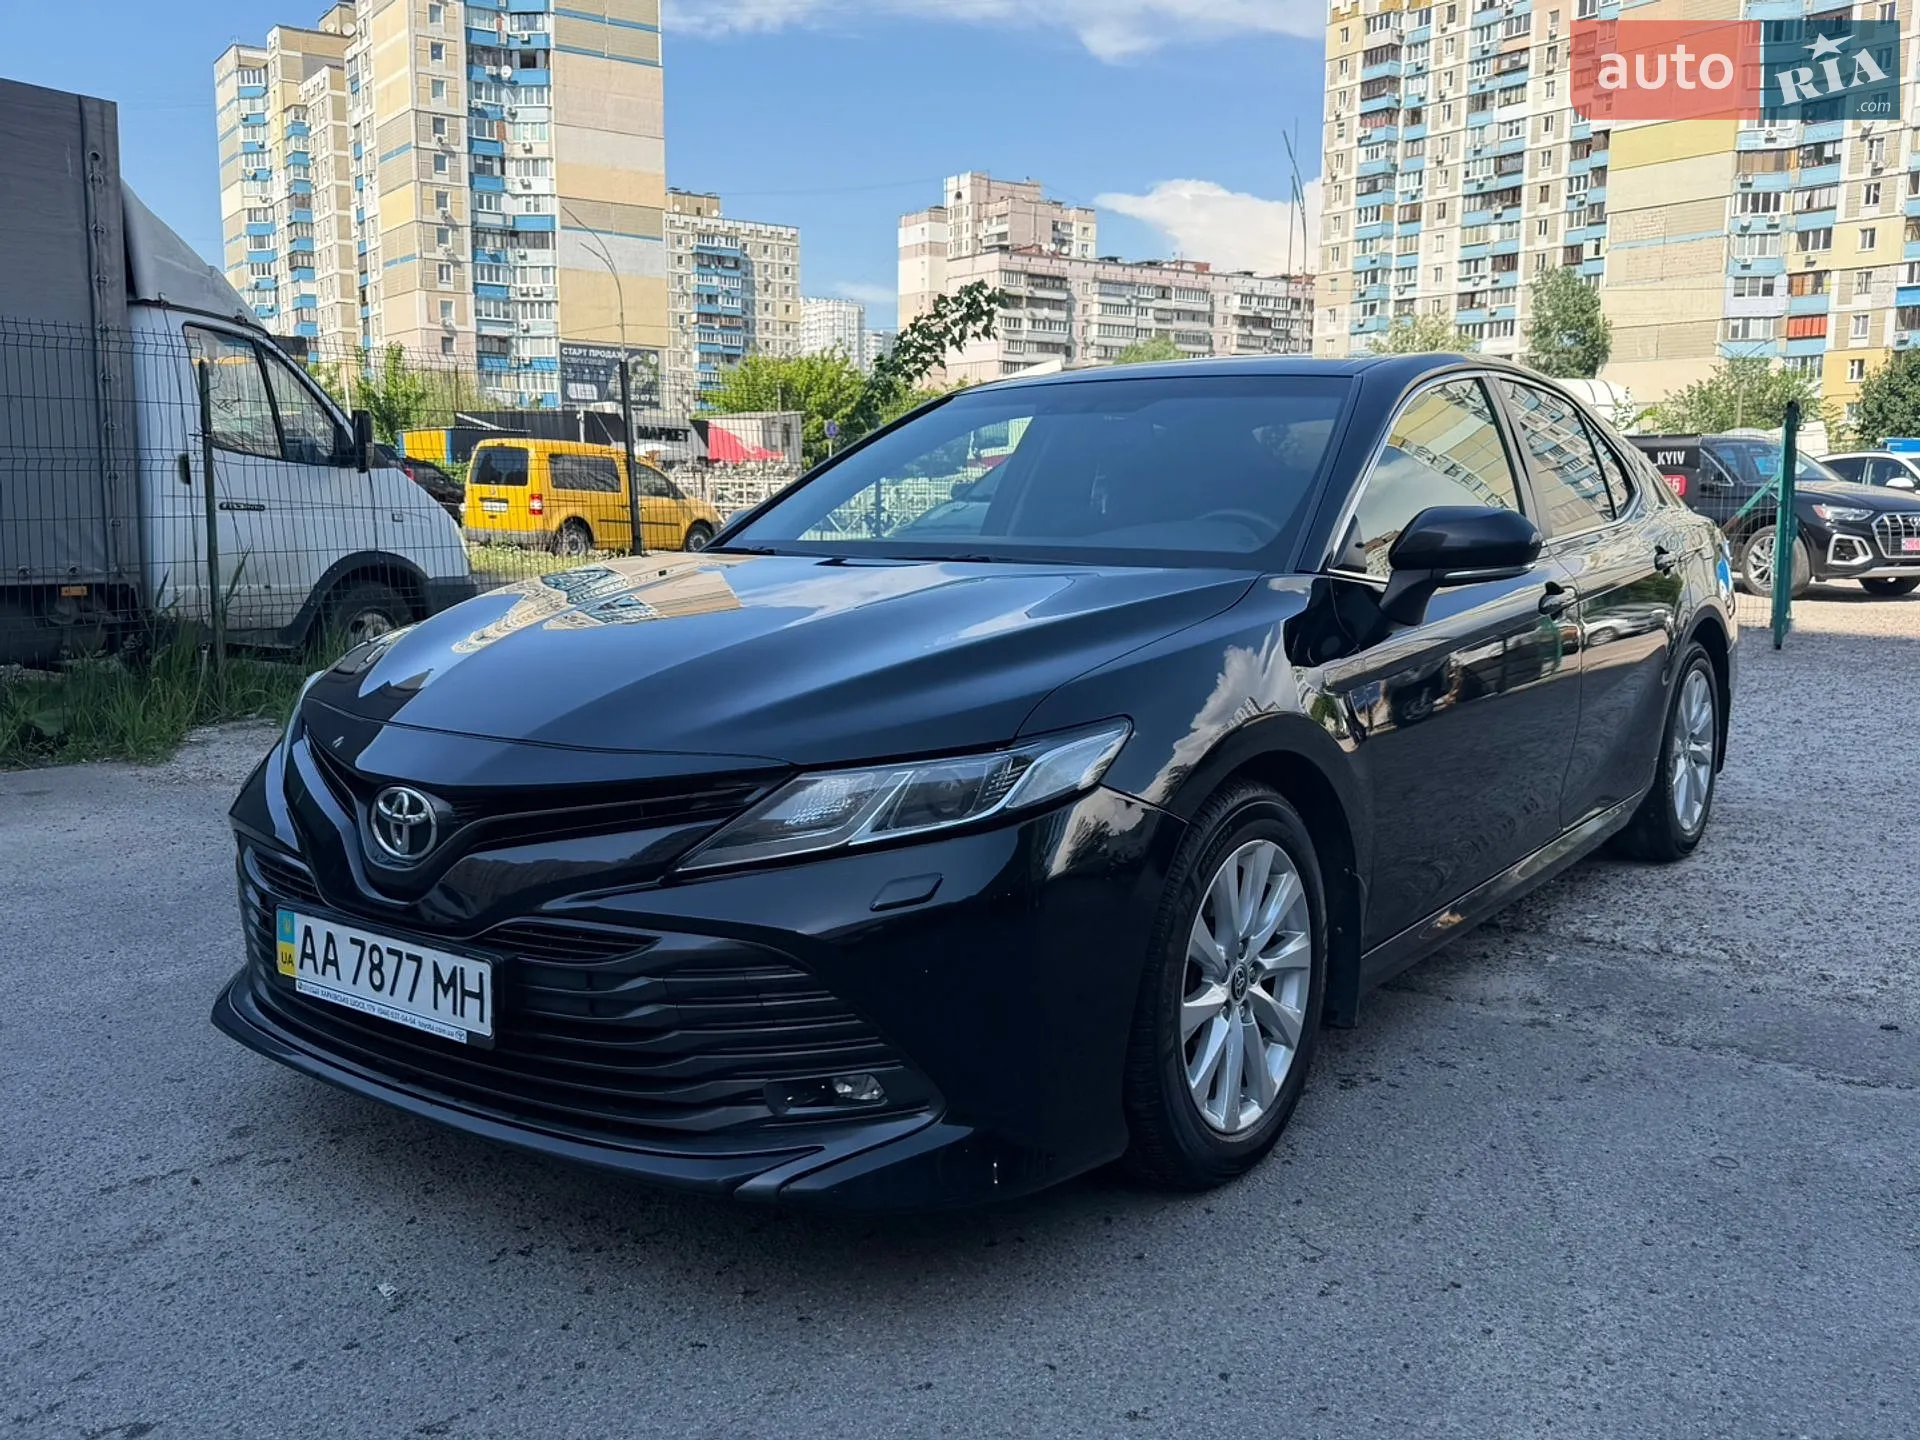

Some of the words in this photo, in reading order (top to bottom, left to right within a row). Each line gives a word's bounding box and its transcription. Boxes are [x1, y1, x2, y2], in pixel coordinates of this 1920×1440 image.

[562, 347, 587, 357] СТАРТ
[637, 426, 691, 442] МАРКЕТ
[281, 951, 294, 966] UA
[299, 924, 342, 981] AA
[349, 936, 423, 1003] 7877
[433, 959, 485, 1024] MH
